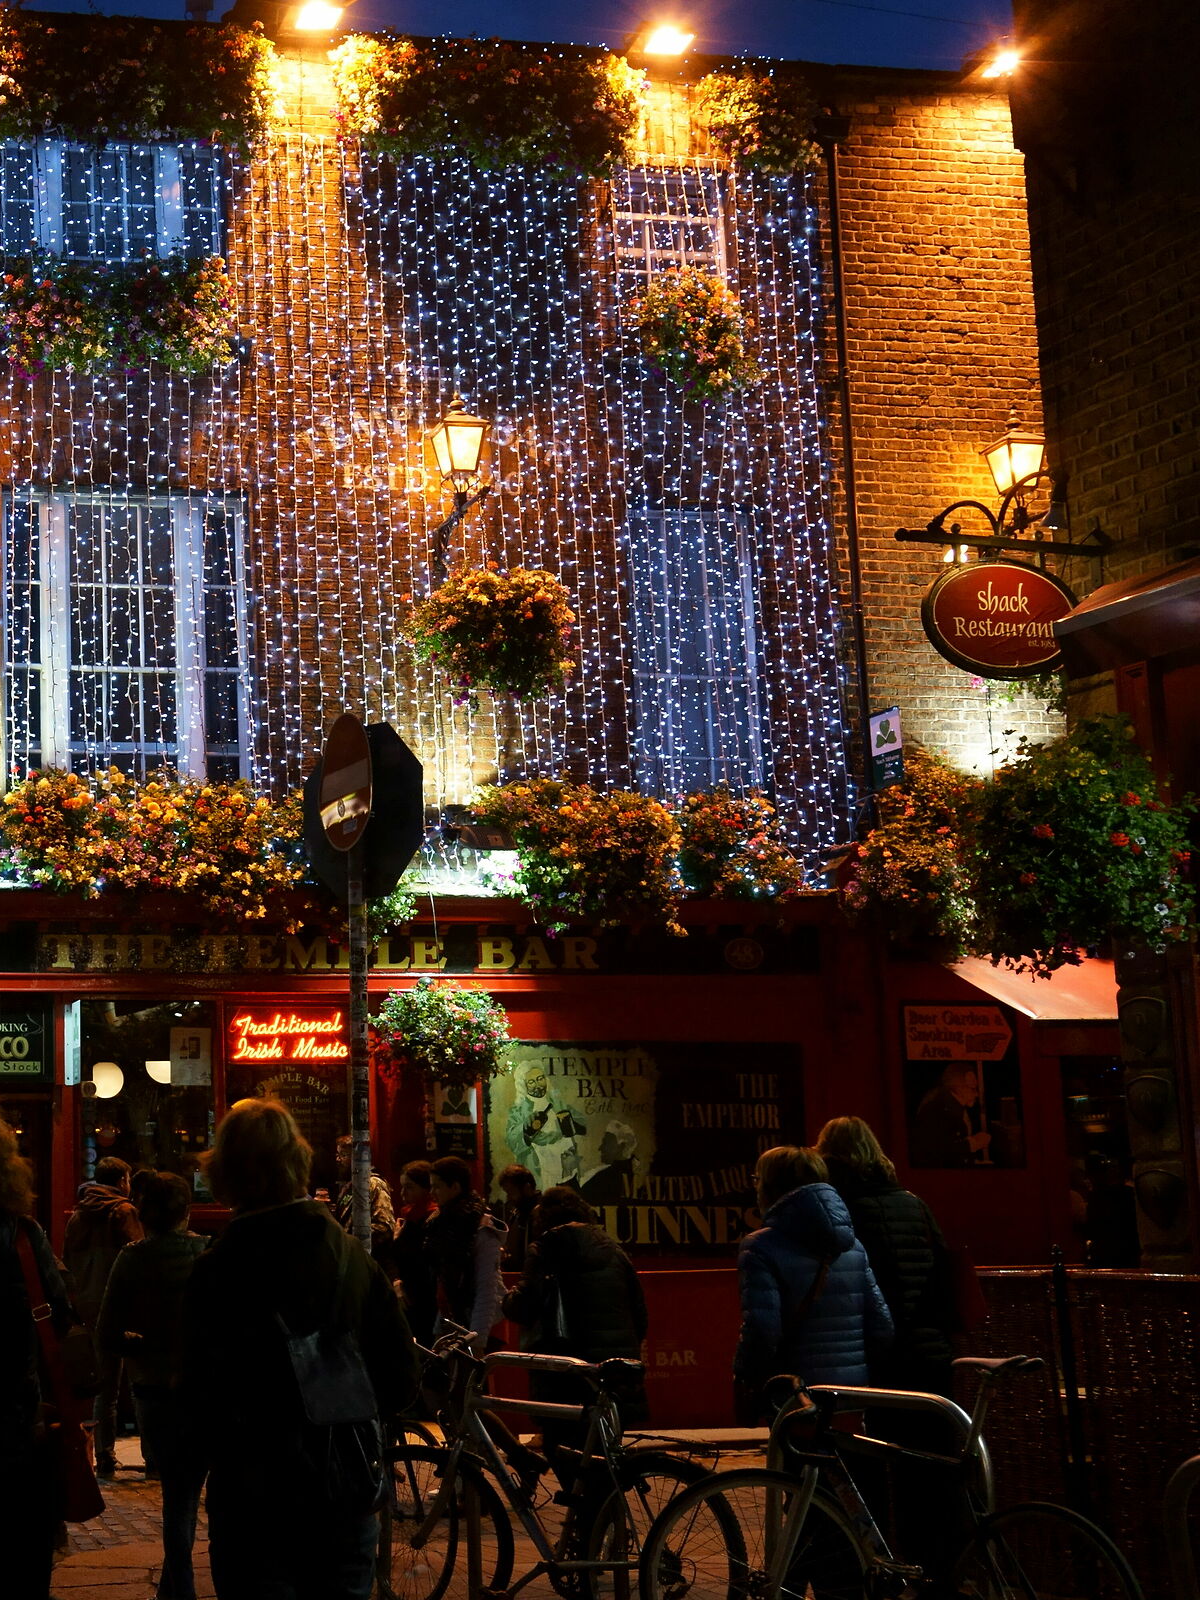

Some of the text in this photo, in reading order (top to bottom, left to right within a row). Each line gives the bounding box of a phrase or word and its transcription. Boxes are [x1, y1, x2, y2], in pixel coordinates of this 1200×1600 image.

[977, 581, 1031, 615] Shack
[953, 616, 1056, 638] Restaurant
[44, 934, 172, 969] THE
[477, 935, 600, 969] BAR
[235, 1011, 343, 1037] Traditional
[943, 1010, 990, 1026] Garden
[907, 1026, 965, 1044] Smoking
[231, 1036, 349, 1060] Irish Music
[922, 1043, 953, 1058] Area
[3, 1060, 40, 1072] Stock
[542, 1055, 650, 1077] TEMPLE
[306, 1075, 330, 1096] BAR
[576, 1078, 629, 1100] BAR
[735, 1072, 780, 1099] THE
[681, 1102, 782, 1130] EMPEROR
[620, 1172, 705, 1202] MALTED
[655, 1349, 697, 1367] BAR
